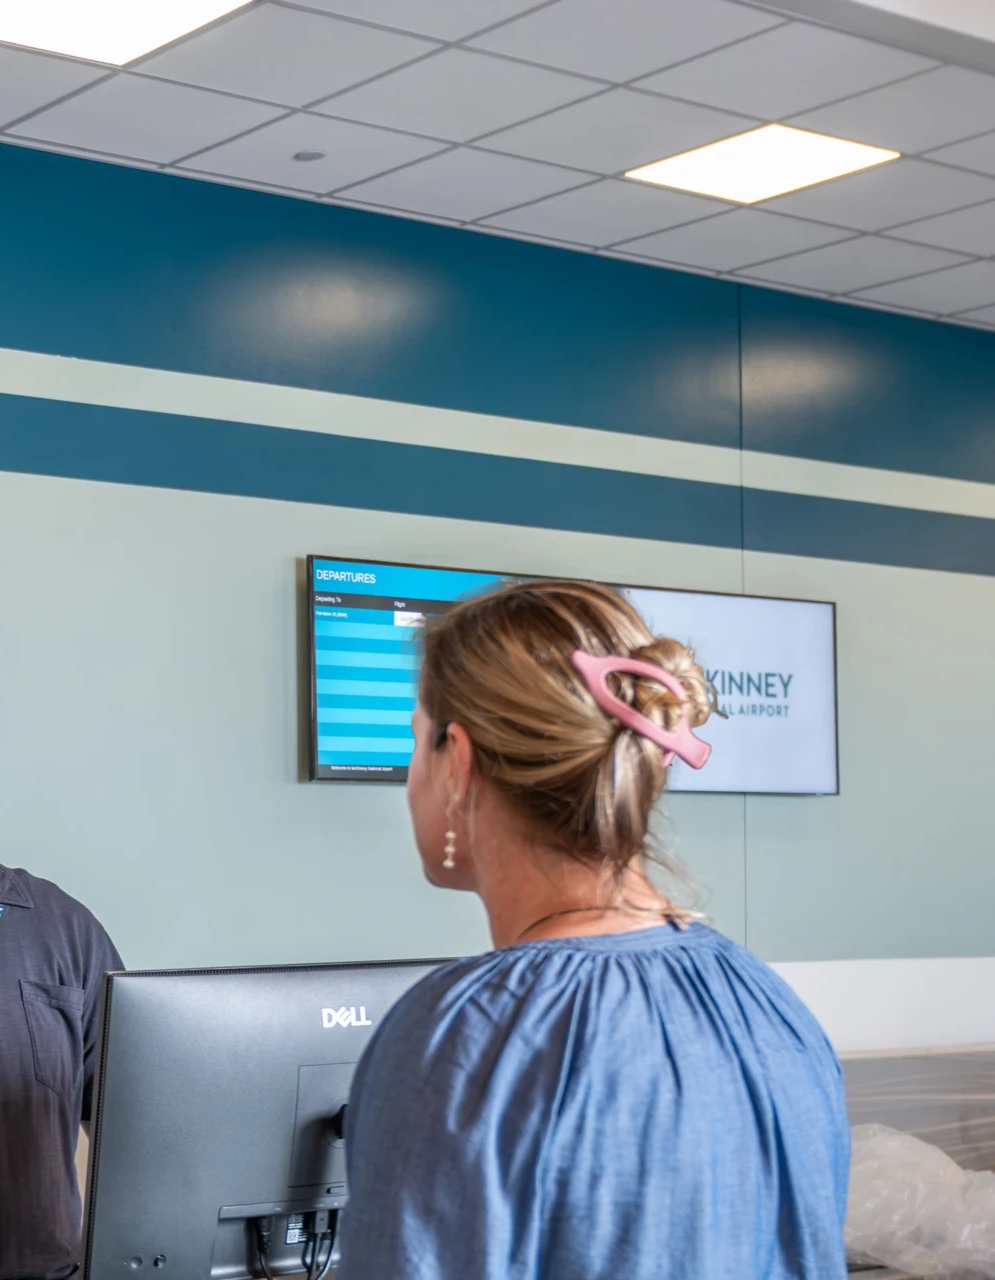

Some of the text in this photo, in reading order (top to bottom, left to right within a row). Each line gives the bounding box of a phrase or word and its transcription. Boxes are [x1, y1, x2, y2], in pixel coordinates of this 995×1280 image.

[316, 570, 376, 584] DEPARTURES
[315, 595, 334, 603] Departing
[394, 600, 405, 608] Flight
[738, 703, 789, 718] AIRPORT
[321, 1006, 372, 1028] DELL
